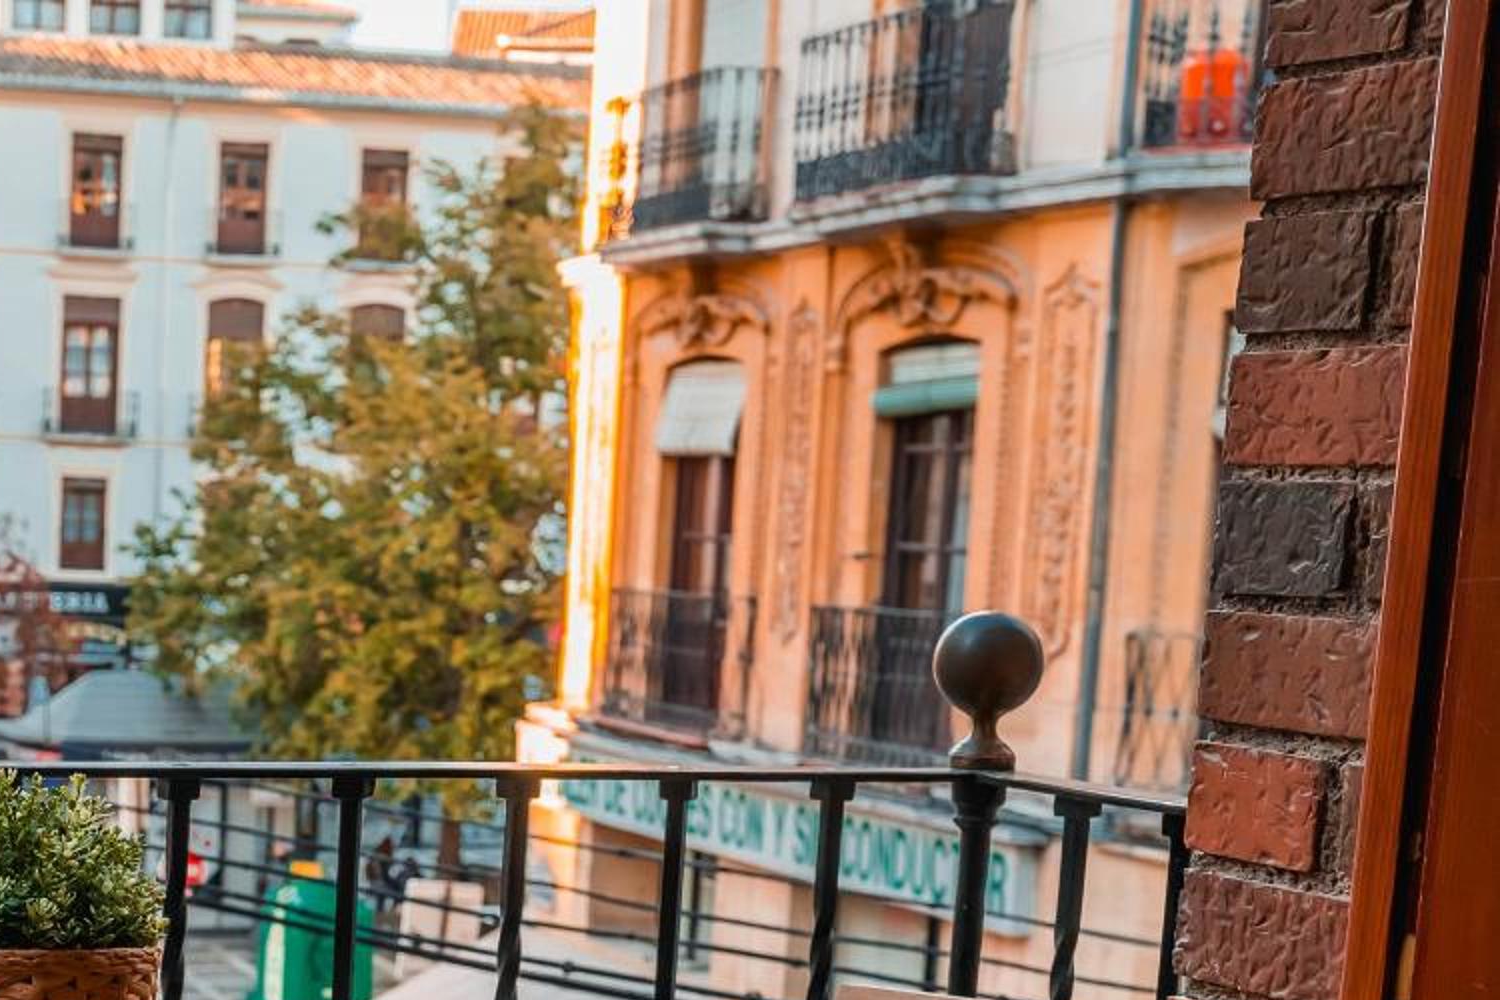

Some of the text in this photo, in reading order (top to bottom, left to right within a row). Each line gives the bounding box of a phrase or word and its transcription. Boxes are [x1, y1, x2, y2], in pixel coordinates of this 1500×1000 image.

[632, 779, 710, 839] COES
[718, 787, 765, 852] CON
[840, 814, 1011, 916] CONDUCR
